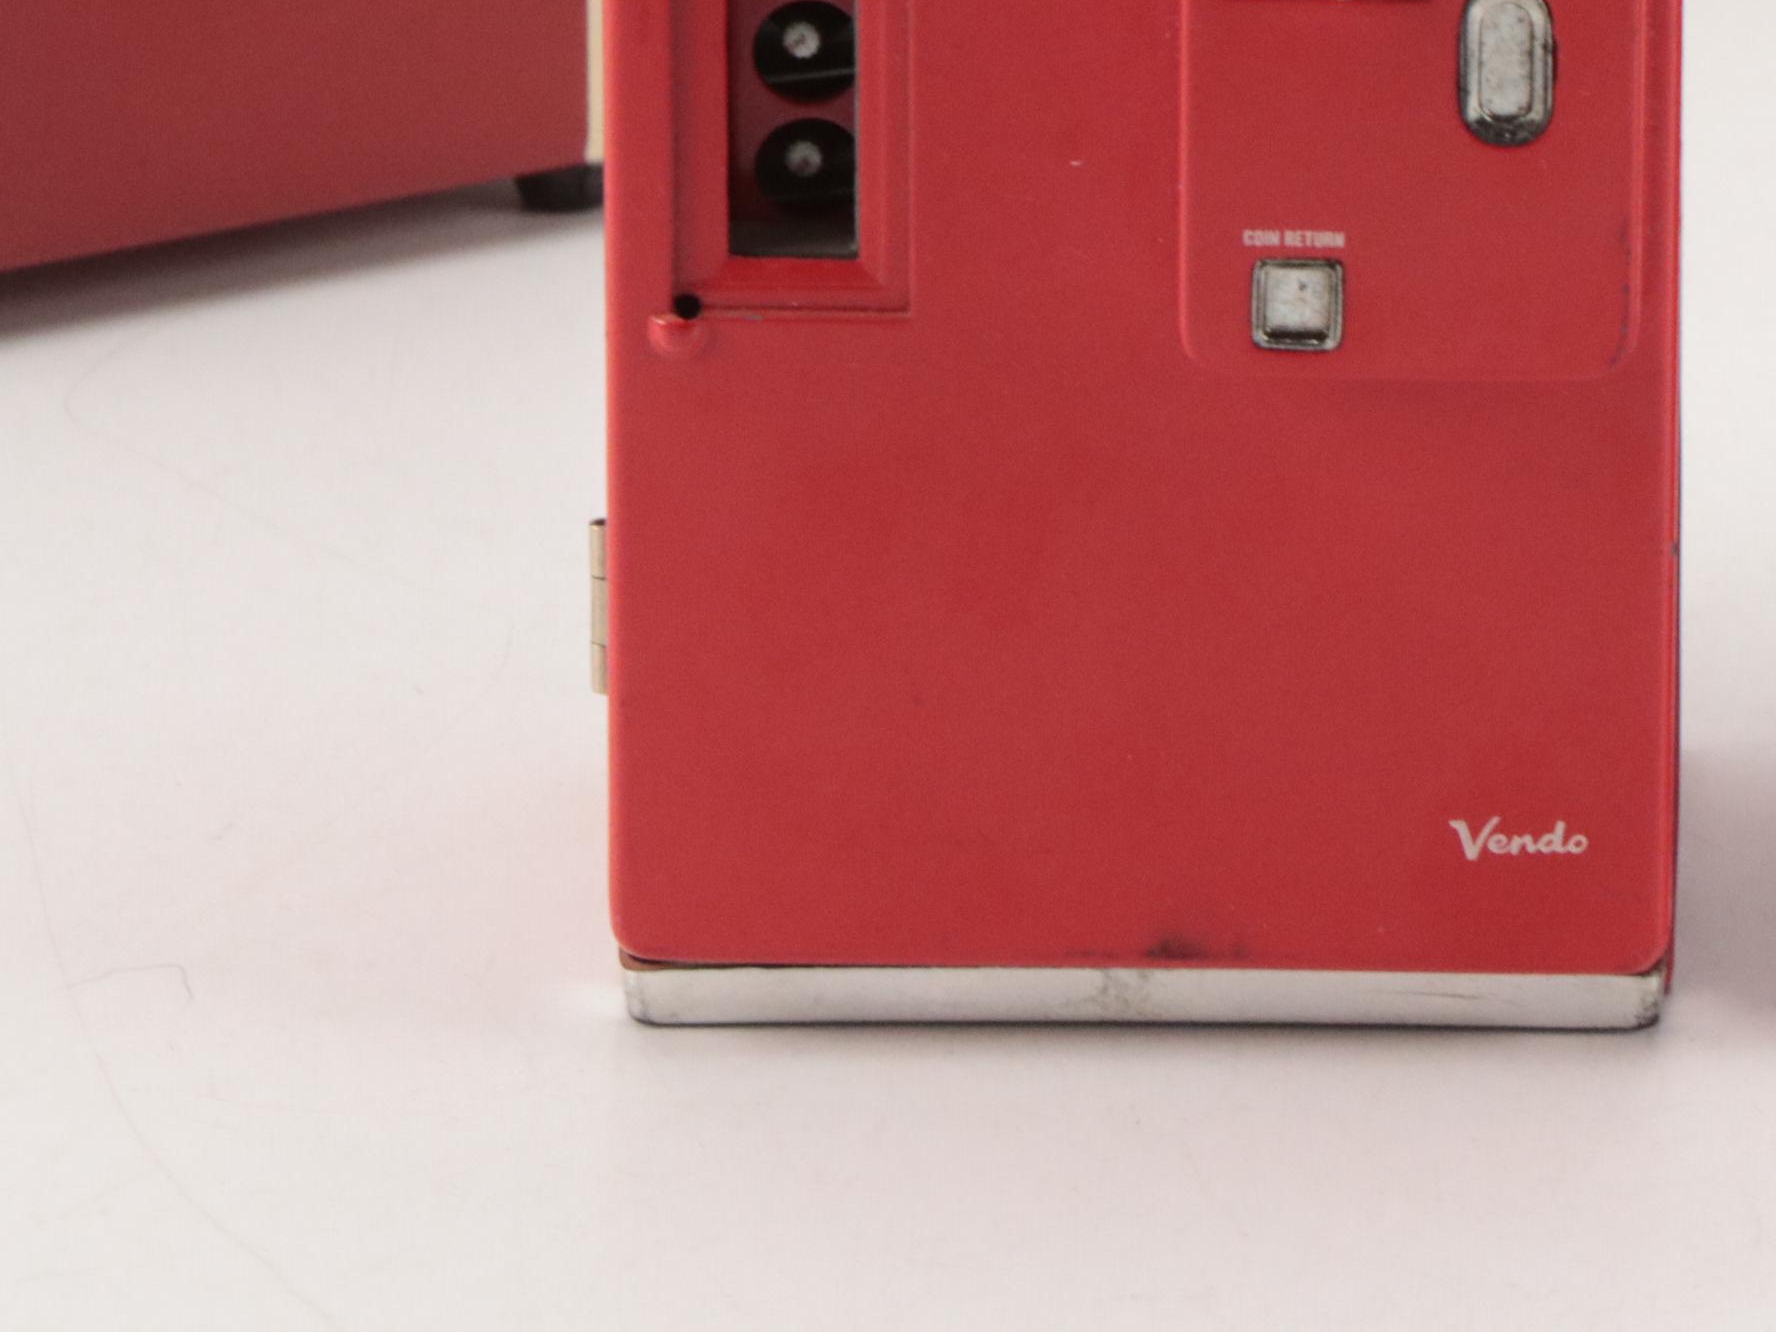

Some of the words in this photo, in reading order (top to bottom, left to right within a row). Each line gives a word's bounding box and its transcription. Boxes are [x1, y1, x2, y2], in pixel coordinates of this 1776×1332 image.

[1243, 229, 1280, 247] COIN
[1284, 231, 1345, 248] RETURN
[1448, 815, 1589, 861] Vendo
